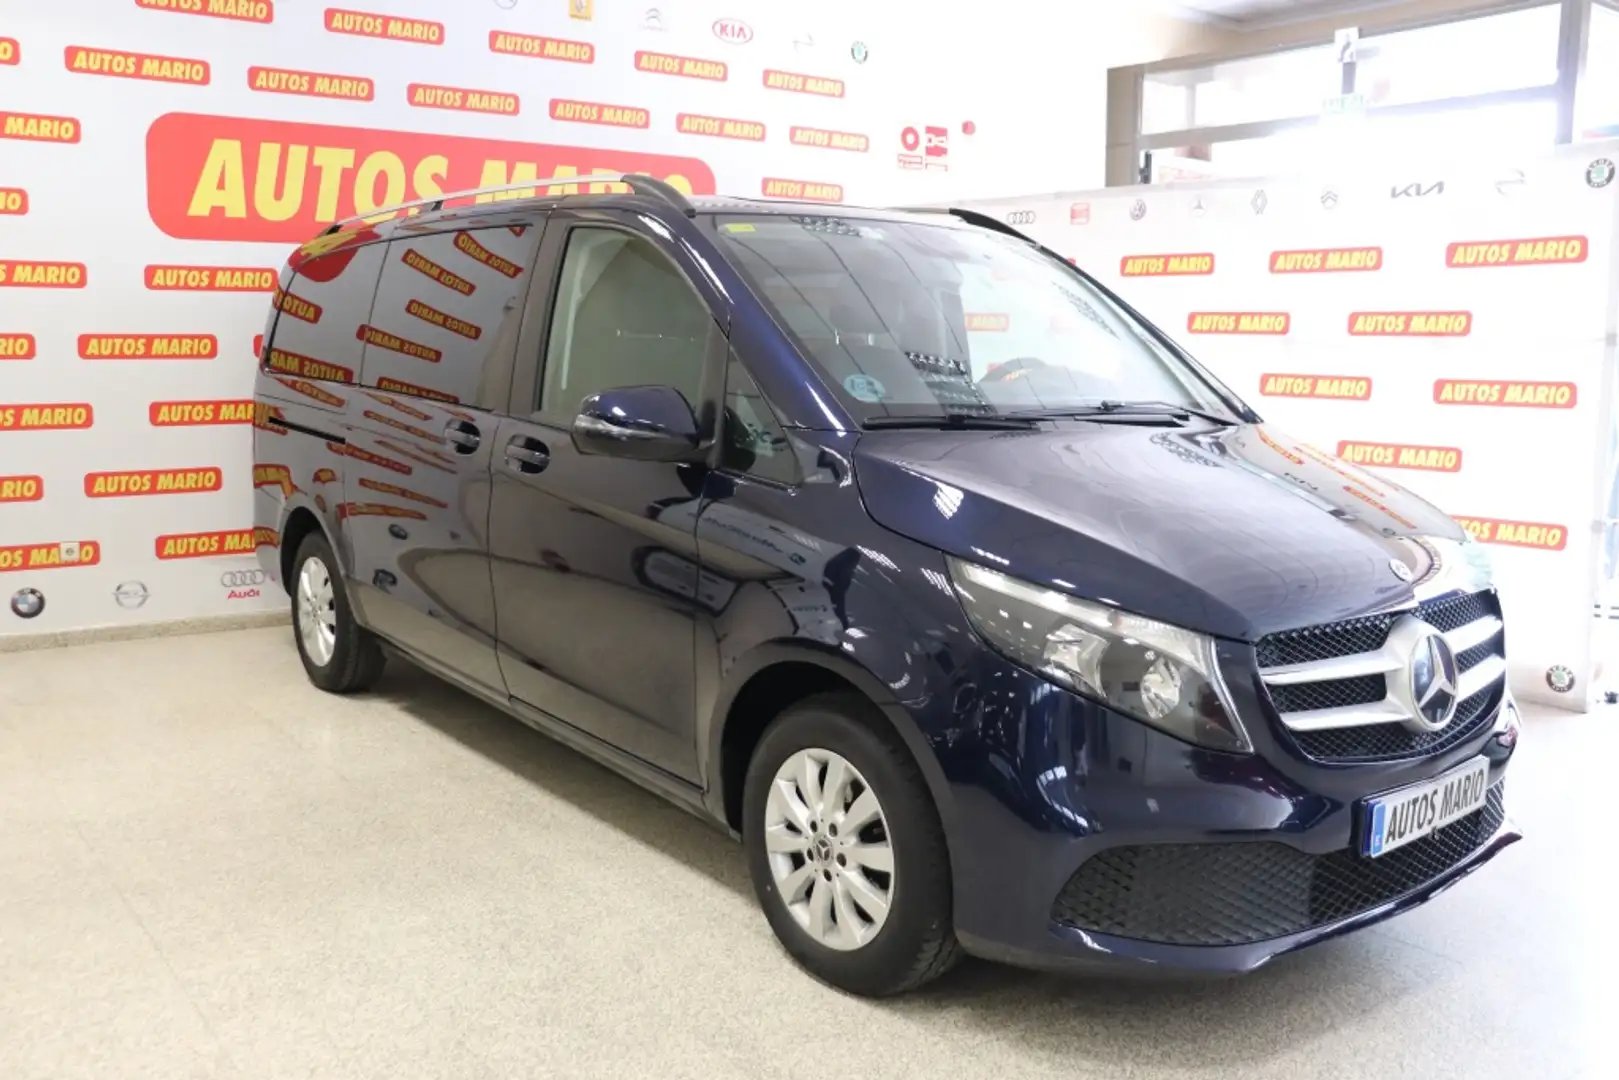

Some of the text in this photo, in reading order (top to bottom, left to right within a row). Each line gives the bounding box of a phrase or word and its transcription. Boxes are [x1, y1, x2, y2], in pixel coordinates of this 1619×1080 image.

[207, 0, 267, 18] MARIO
[331, 13, 439, 40] AUTOS MARIO
[719, 22, 748, 39] KIA
[495, 35, 590, 58] AUTOS MARIO
[72, 50, 204, 81] AUTOS MARIO
[641, 55, 724, 77] AUTOS MARIO
[255, 70, 368, 96] AUTOS MARIO
[768, 73, 841, 94] AUTOS MARIO
[414, 88, 515, 111] AUTOS MARIO
[556, 103, 644, 123] AUTOS MARIO
[3, 117, 75, 139] MARIO
[682, 118, 762, 137] AUTOS MARIO
[795, 130, 865, 148] AUTOS MARIO
[187, 139, 449, 223] AUTOS
[767, 181, 841, 198] AUTOS MARIO
[1276, 252, 1378, 270] AUTOS MARIO
[1454, 240, 1581, 263] AUTOS MARIO
[12, 265, 81, 284] MARIO
[1125, 256, 1211, 274] AUTOS MARIO
[152, 268, 273, 288] AUTOS MARIO
[1192, 314, 1286, 332] AUTOS MARIO
[1354, 315, 1467, 332] AUTOS MARIO
[85, 337, 212, 356] AUTOS MARIO
[1265, 376, 1368, 397] AUTOS MARIO
[1440, 382, 1572, 404] AUTOS MARIO
[20, 407, 87, 426] MARIO
[157, 404, 215, 422] AUTOS
[1340, 444, 1457, 468] AUTOS MARIO
[92, 471, 217, 494] AUTOS MARIO
[1495, 524, 1561, 546] MARIO
[28, 545, 95, 566] MAO
[161, 536, 220, 556] AUTOS
[1385, 768, 1484, 844] AUTOS MARIO
